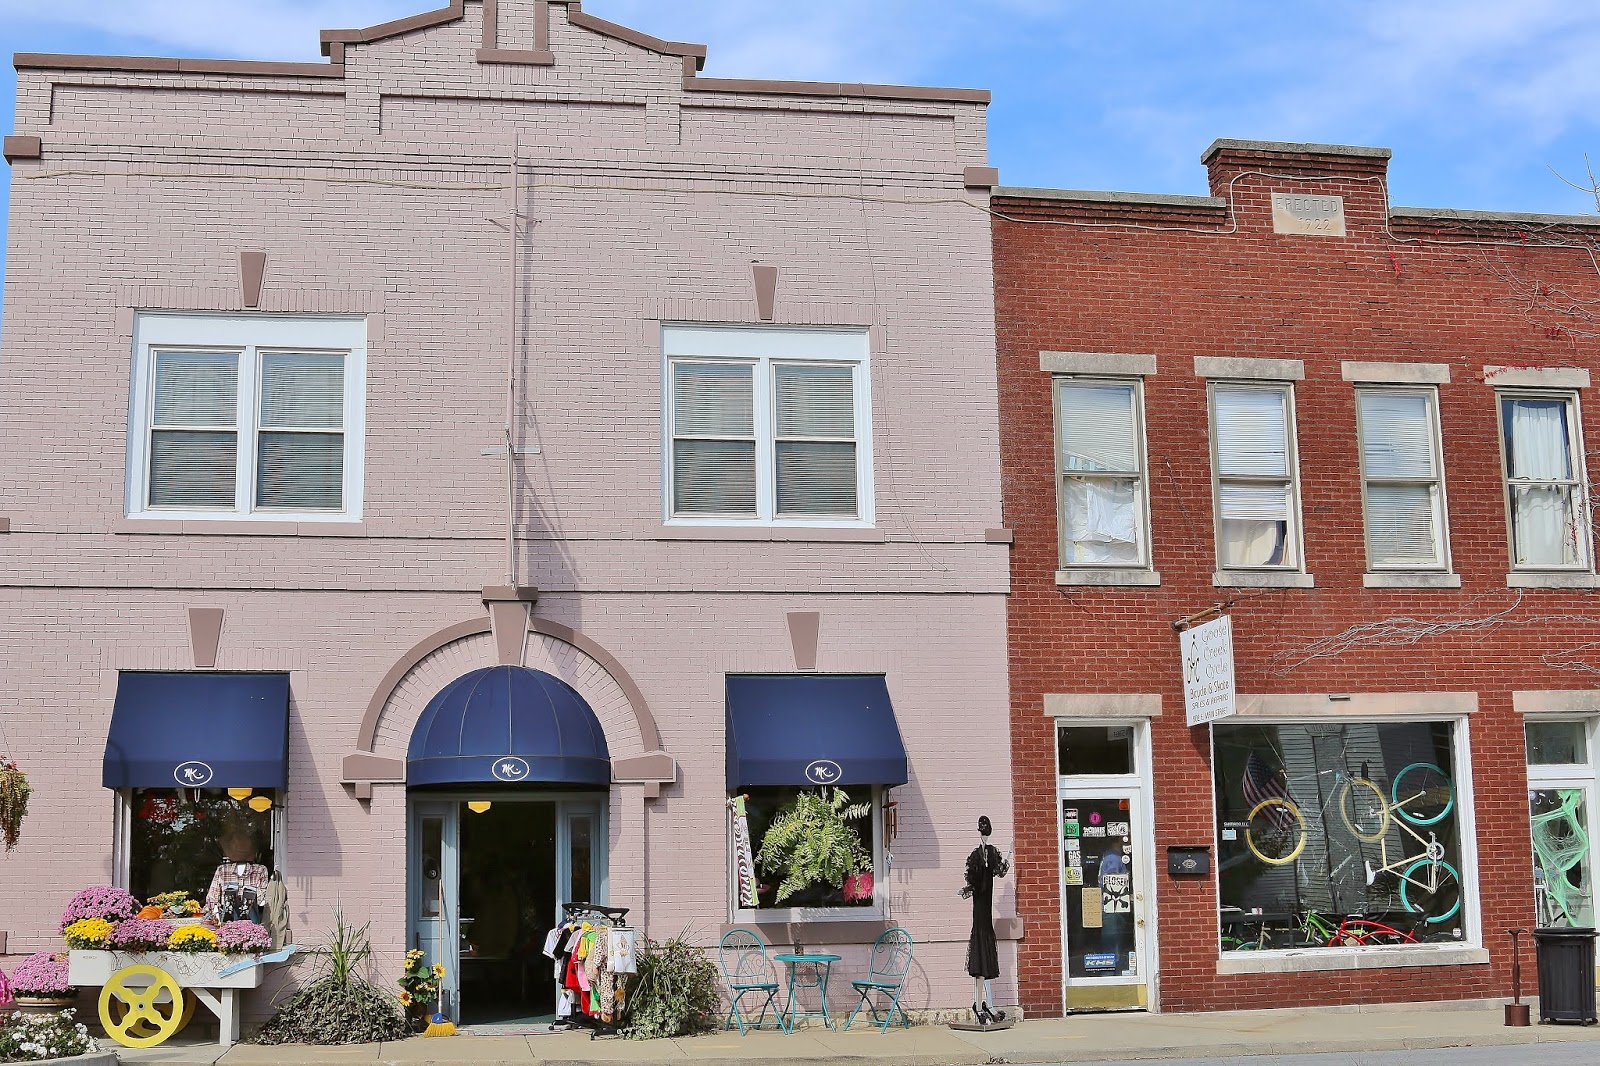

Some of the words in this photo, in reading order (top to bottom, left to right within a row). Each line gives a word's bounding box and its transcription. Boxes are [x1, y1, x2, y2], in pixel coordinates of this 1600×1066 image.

[1276, 197, 1338, 212] ERECTED
[1202, 625, 1227, 645] Goose
[1204, 639, 1228, 661] Creek
[1205, 657, 1228, 679] Cycle
